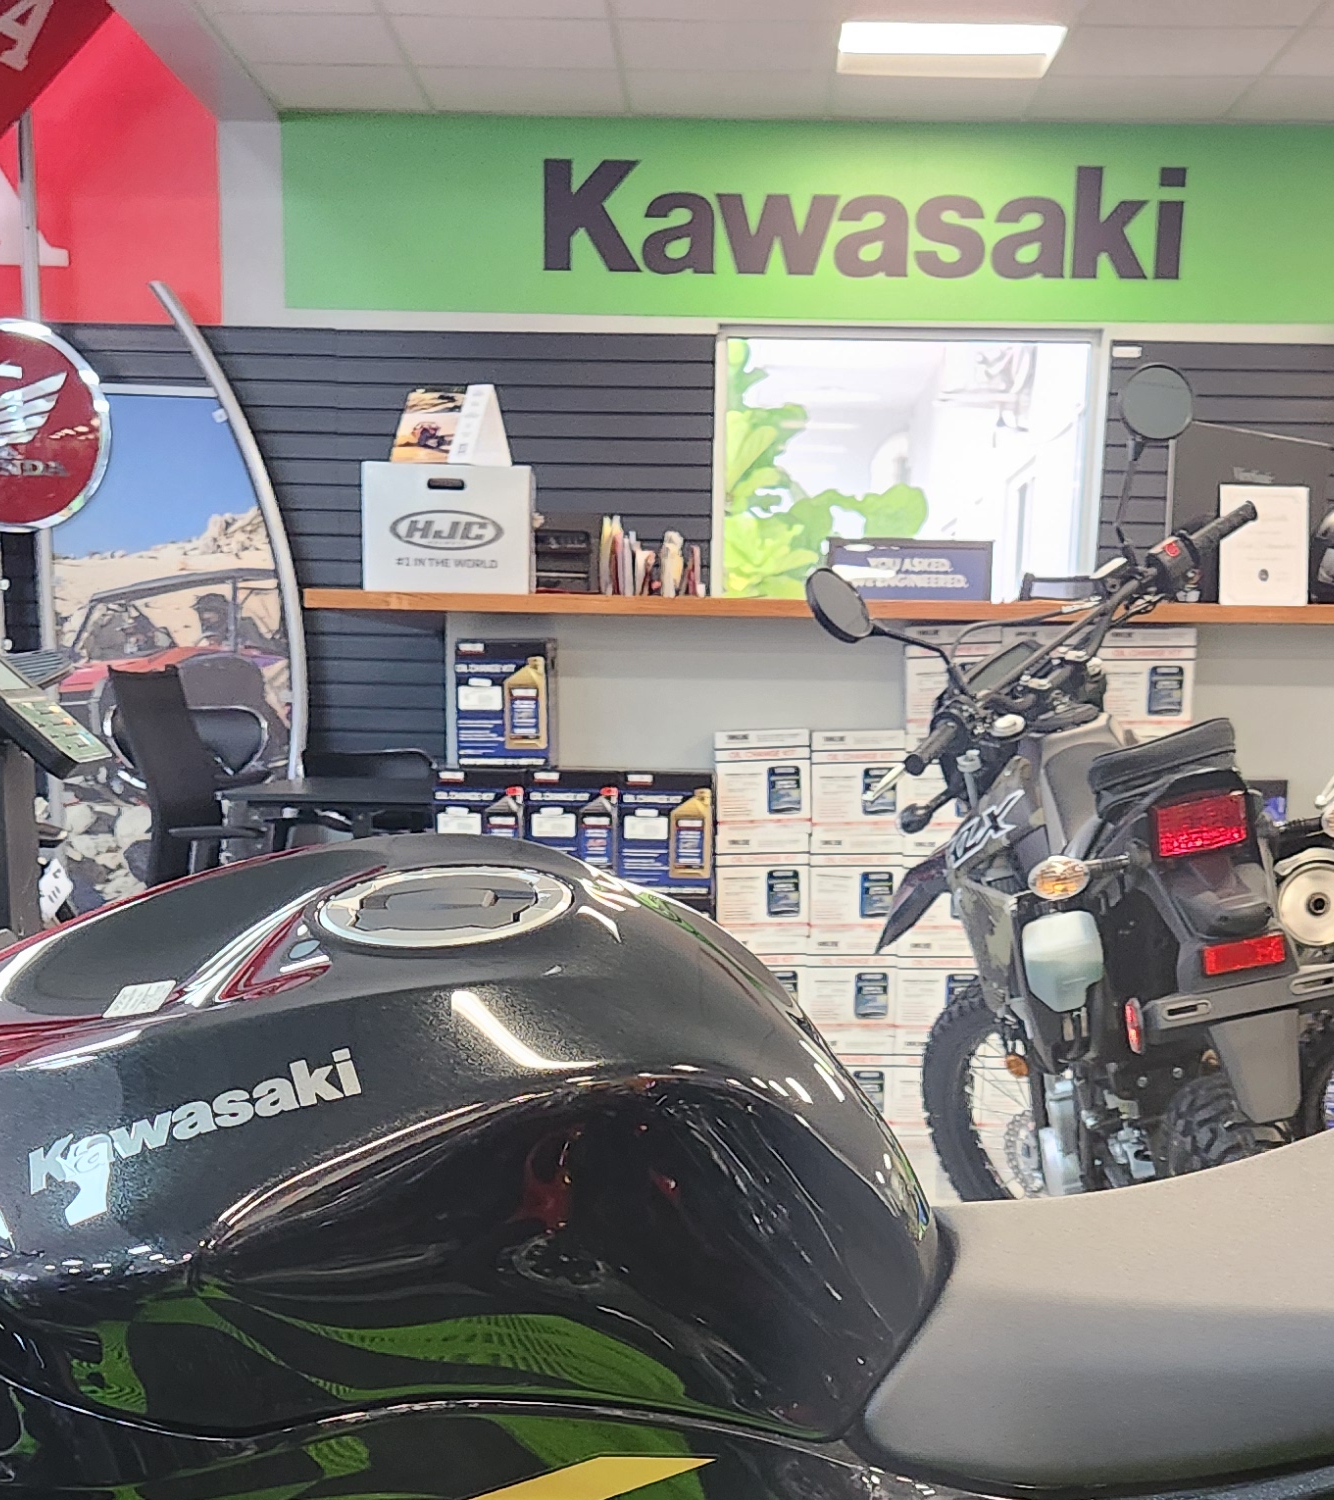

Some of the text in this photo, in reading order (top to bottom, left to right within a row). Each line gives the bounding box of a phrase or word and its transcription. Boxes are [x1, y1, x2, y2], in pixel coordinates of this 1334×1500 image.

[542, 158, 1187, 281] Kawasaki
[404, 519, 489, 541] HJC
[395, 557, 499, 569] #1 IN THE WORLD
[867, 557, 901, 572] YOU
[27, 1046, 363, 1196] Kawasaki
